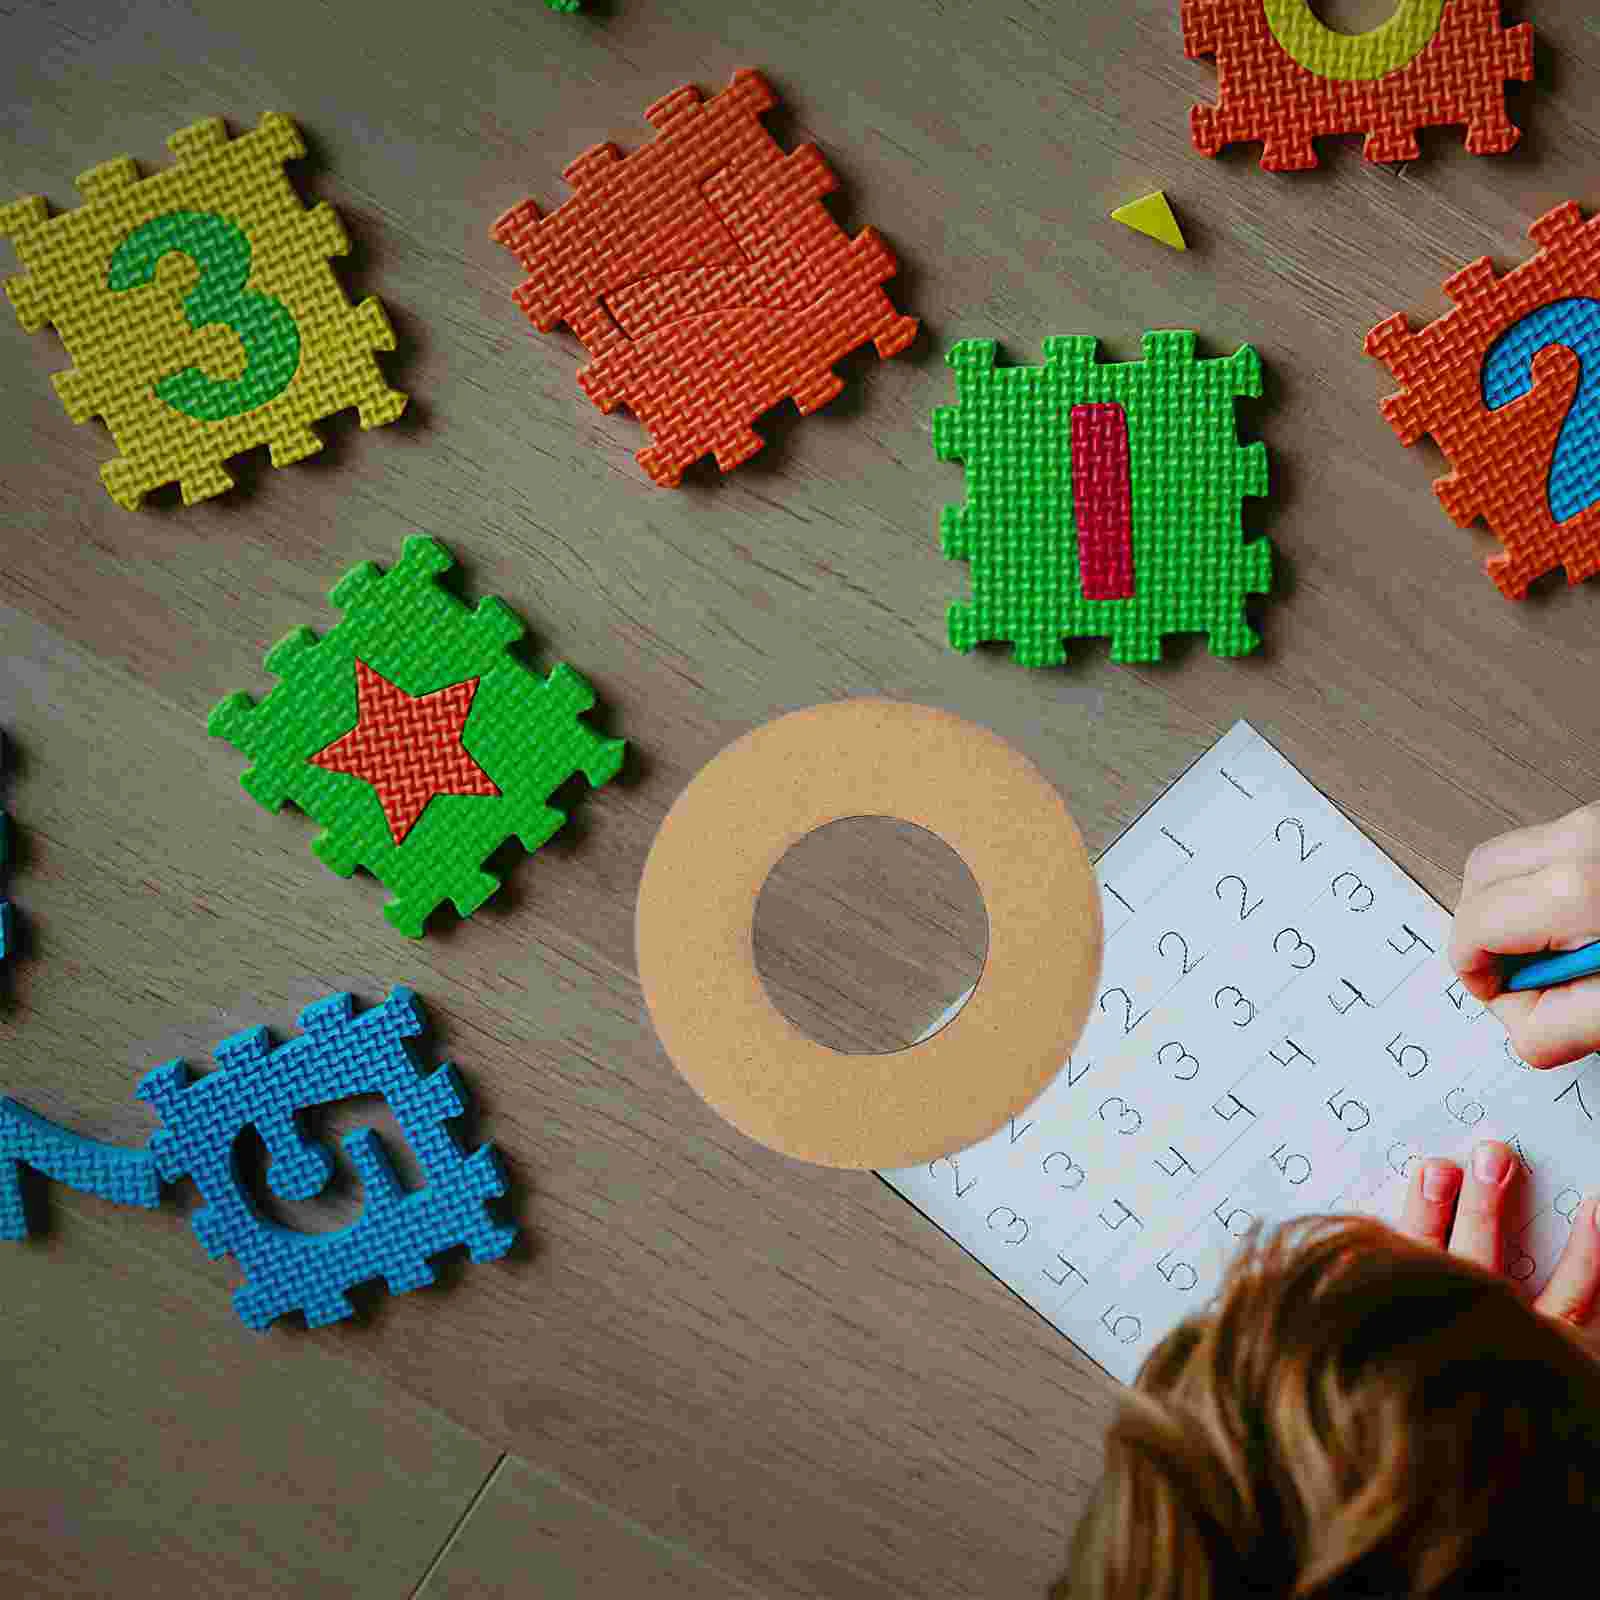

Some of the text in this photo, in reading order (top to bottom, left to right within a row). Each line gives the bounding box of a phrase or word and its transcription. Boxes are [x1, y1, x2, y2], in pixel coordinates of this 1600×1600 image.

[108, 210, 302, 421] 3
[1099, 988, 1151, 1034] 2
[1158, 931, 1204, 977] 2
[1216, 875, 1264, 920] 2
[1274, 817, 1322, 862] 2
[986, 872, 1374, 1245] 3 3 3 3 3 3 3
[1042, 924, 1436, 1286] 4 4 4 4 4 4 4
[1100, 1305, 1141, 1343] 5
[1156, 1253, 1198, 1291] 5
[1213, 1198, 1256, 1238] 5
[1268, 1144, 1312, 1184] 5
[1326, 1088, 1370, 1132] 5
[1385, 1032, 1429, 1078] 5
[1553, 1079, 1592, 1120] 7
